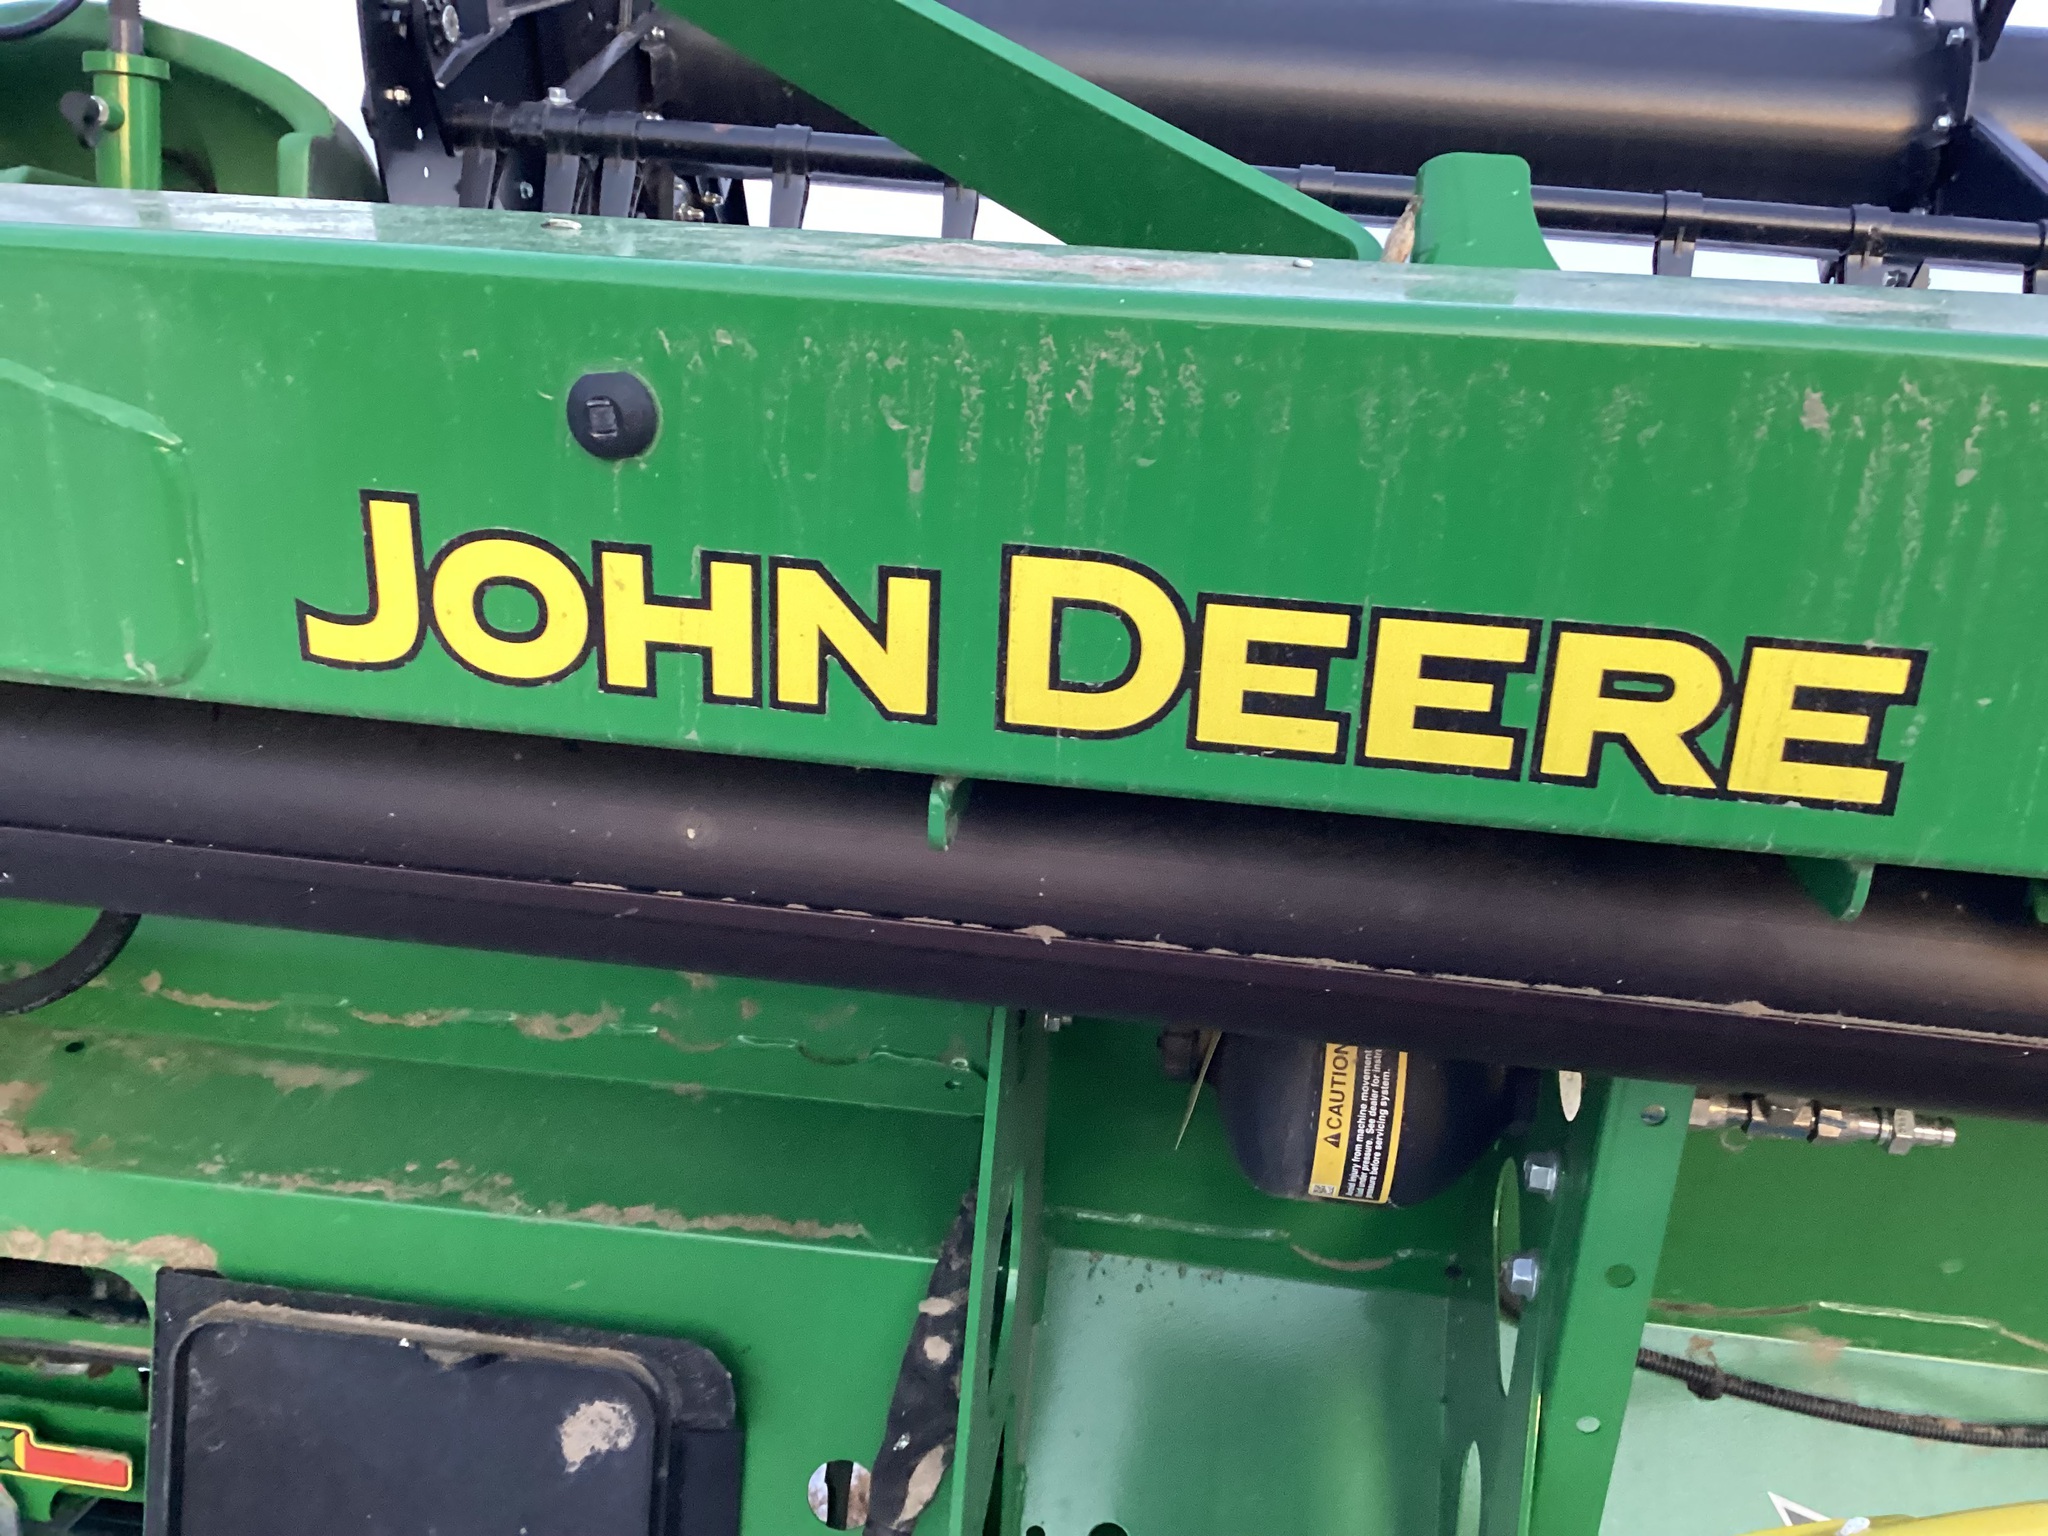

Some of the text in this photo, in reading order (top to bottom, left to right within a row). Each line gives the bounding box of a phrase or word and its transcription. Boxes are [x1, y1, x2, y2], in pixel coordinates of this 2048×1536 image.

[296, 489, 1929, 815] JOHN DEERE
[1361, 1050, 1373, 1101] movement
[1370, 1074, 1380, 1087] for
[1380, 1069, 1391, 1106] system.
[1368, 1089, 1379, 1116] dealer
[1356, 1103, 1368, 1142] machine
[1365, 1118, 1376, 1134] See
[1375, 1108, 1389, 1150] servicing
[1351, 1144, 1363, 1162] from
[1361, 1138, 1374, 1172] pressure.
[1369, 1152, 1382, 1175] before
